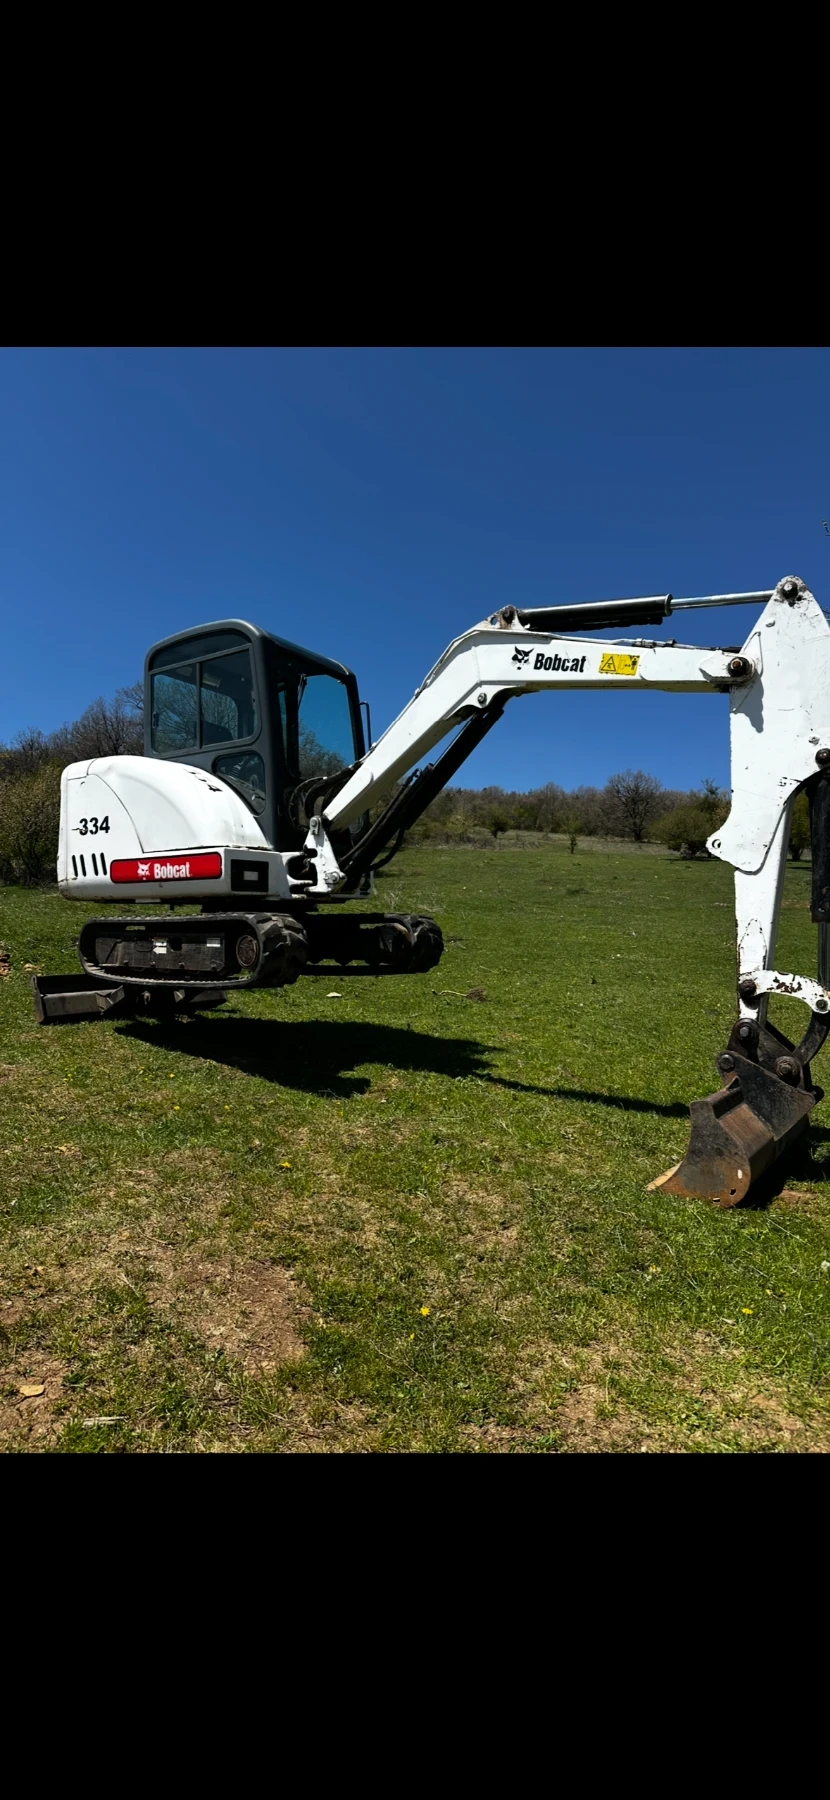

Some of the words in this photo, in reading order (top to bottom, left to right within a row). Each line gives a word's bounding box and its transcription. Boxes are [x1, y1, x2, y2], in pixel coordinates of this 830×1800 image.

[534, 653, 586, 673] Bobcat
[79, 816, 110, 835] 334
[154, 862, 191, 879] Bobcat
